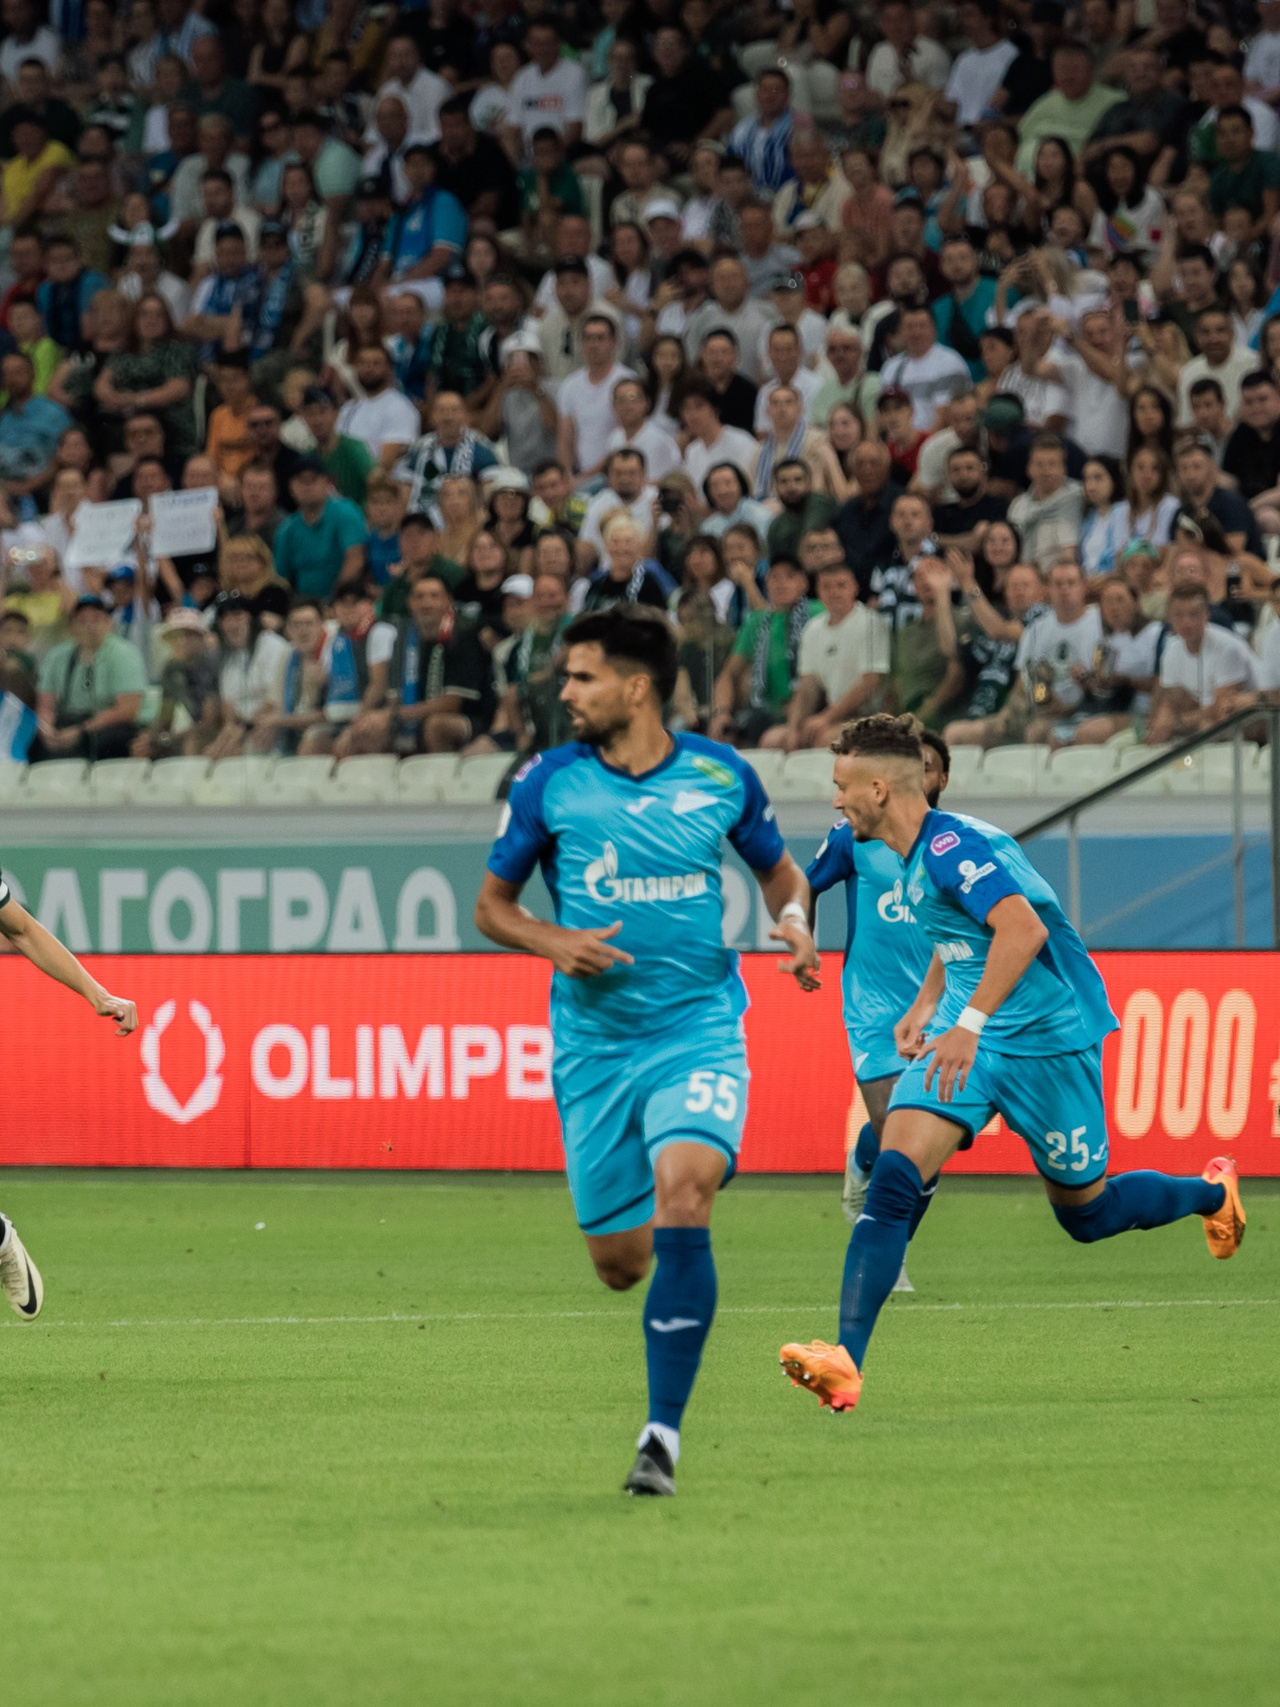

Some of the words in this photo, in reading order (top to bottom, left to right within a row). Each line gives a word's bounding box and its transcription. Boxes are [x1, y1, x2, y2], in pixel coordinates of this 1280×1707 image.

[249, 1023, 556, 1100] OLIMPB
[685, 1070, 740, 1122] 55
[1045, 1125, 1091, 1173] 25
